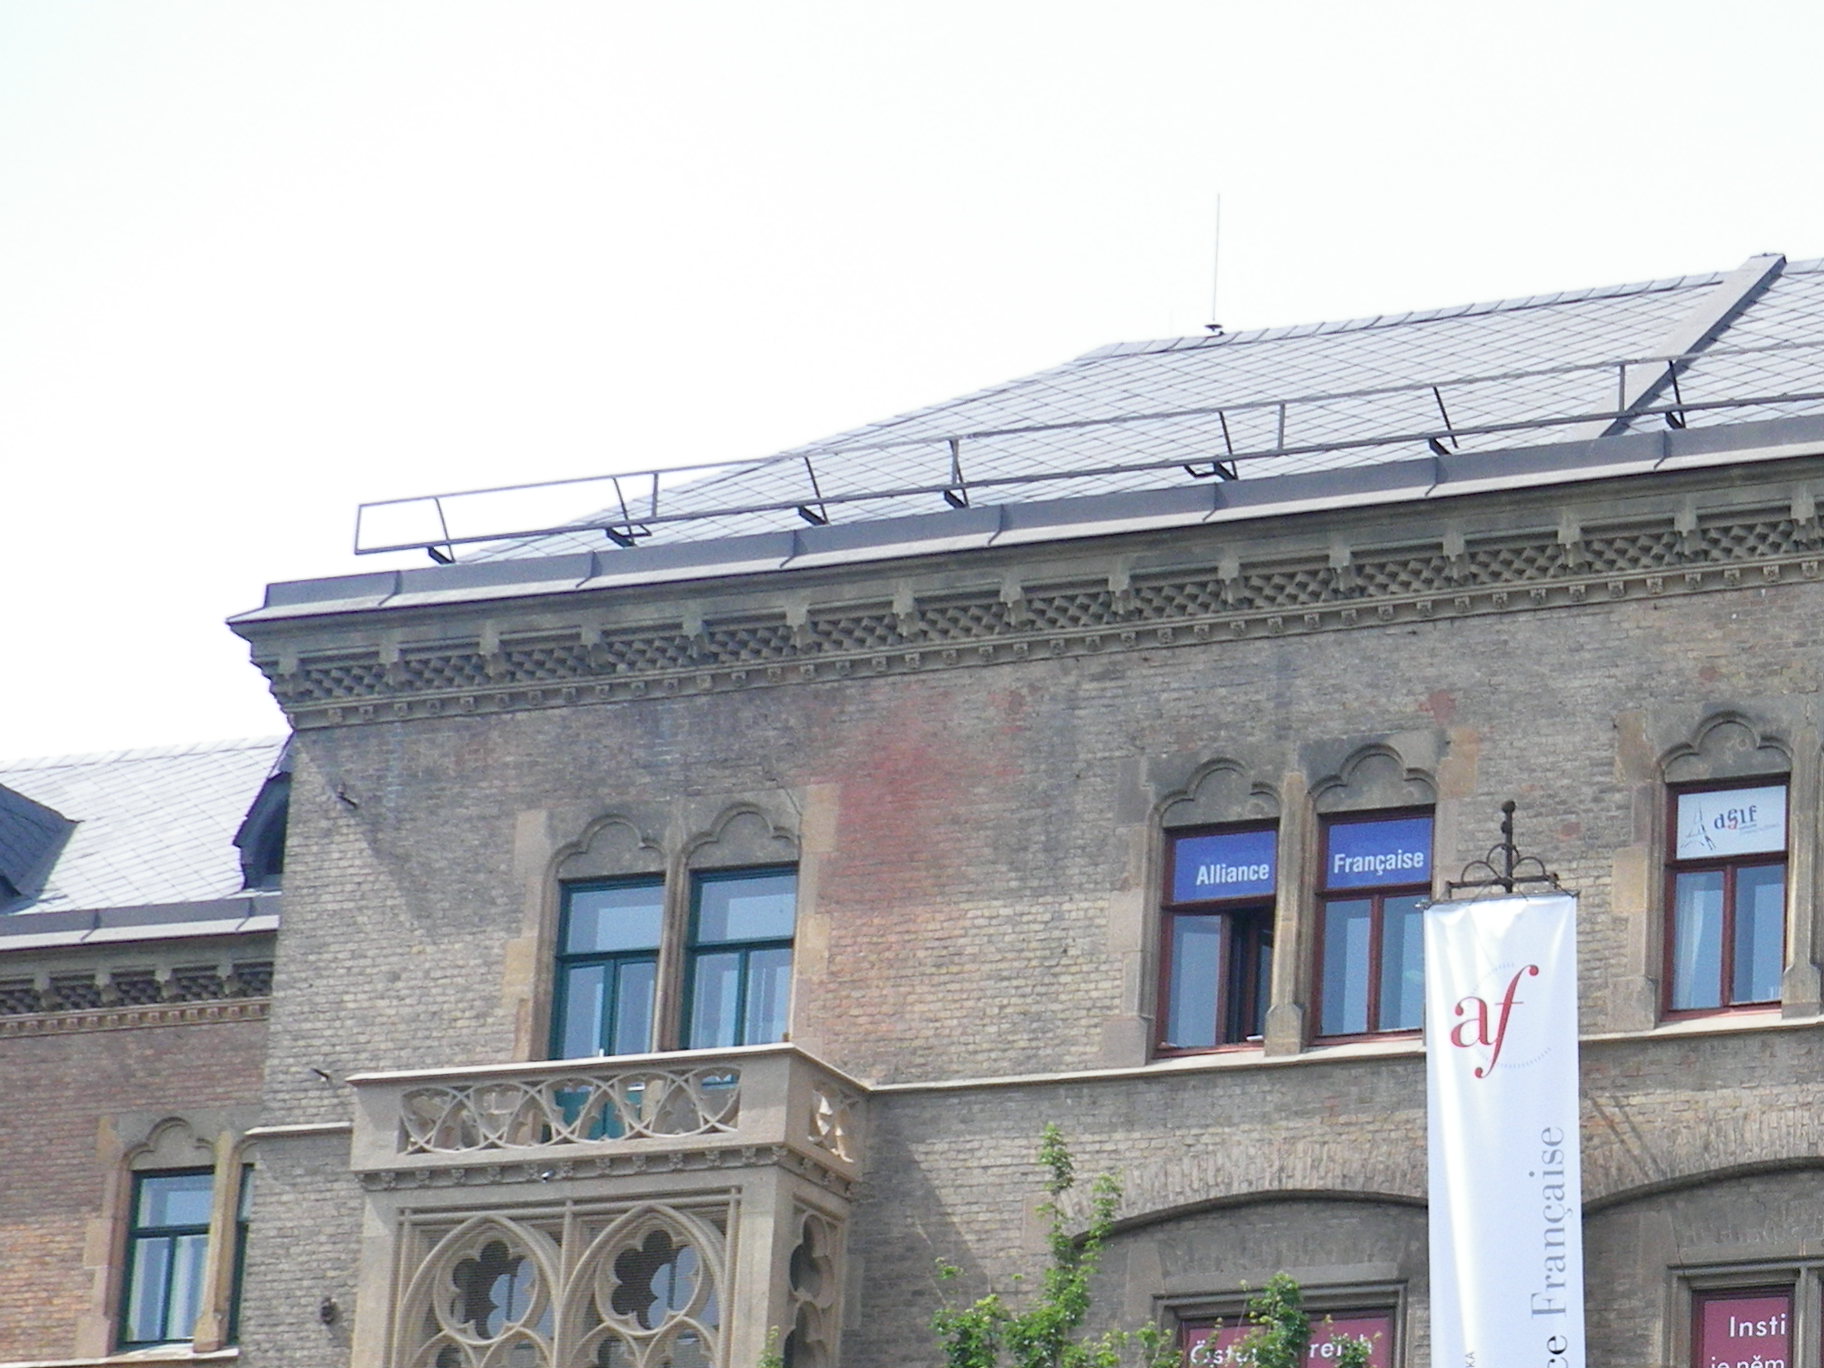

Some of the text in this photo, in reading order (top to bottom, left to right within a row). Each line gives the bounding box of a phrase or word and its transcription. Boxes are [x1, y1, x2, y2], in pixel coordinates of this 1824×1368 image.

[1196, 849, 1424, 887] Alliance Française
[1450, 964, 1540, 1079] af
[1528, 1125, 1573, 1320] Française
[1729, 1313, 1787, 1338] Insti
